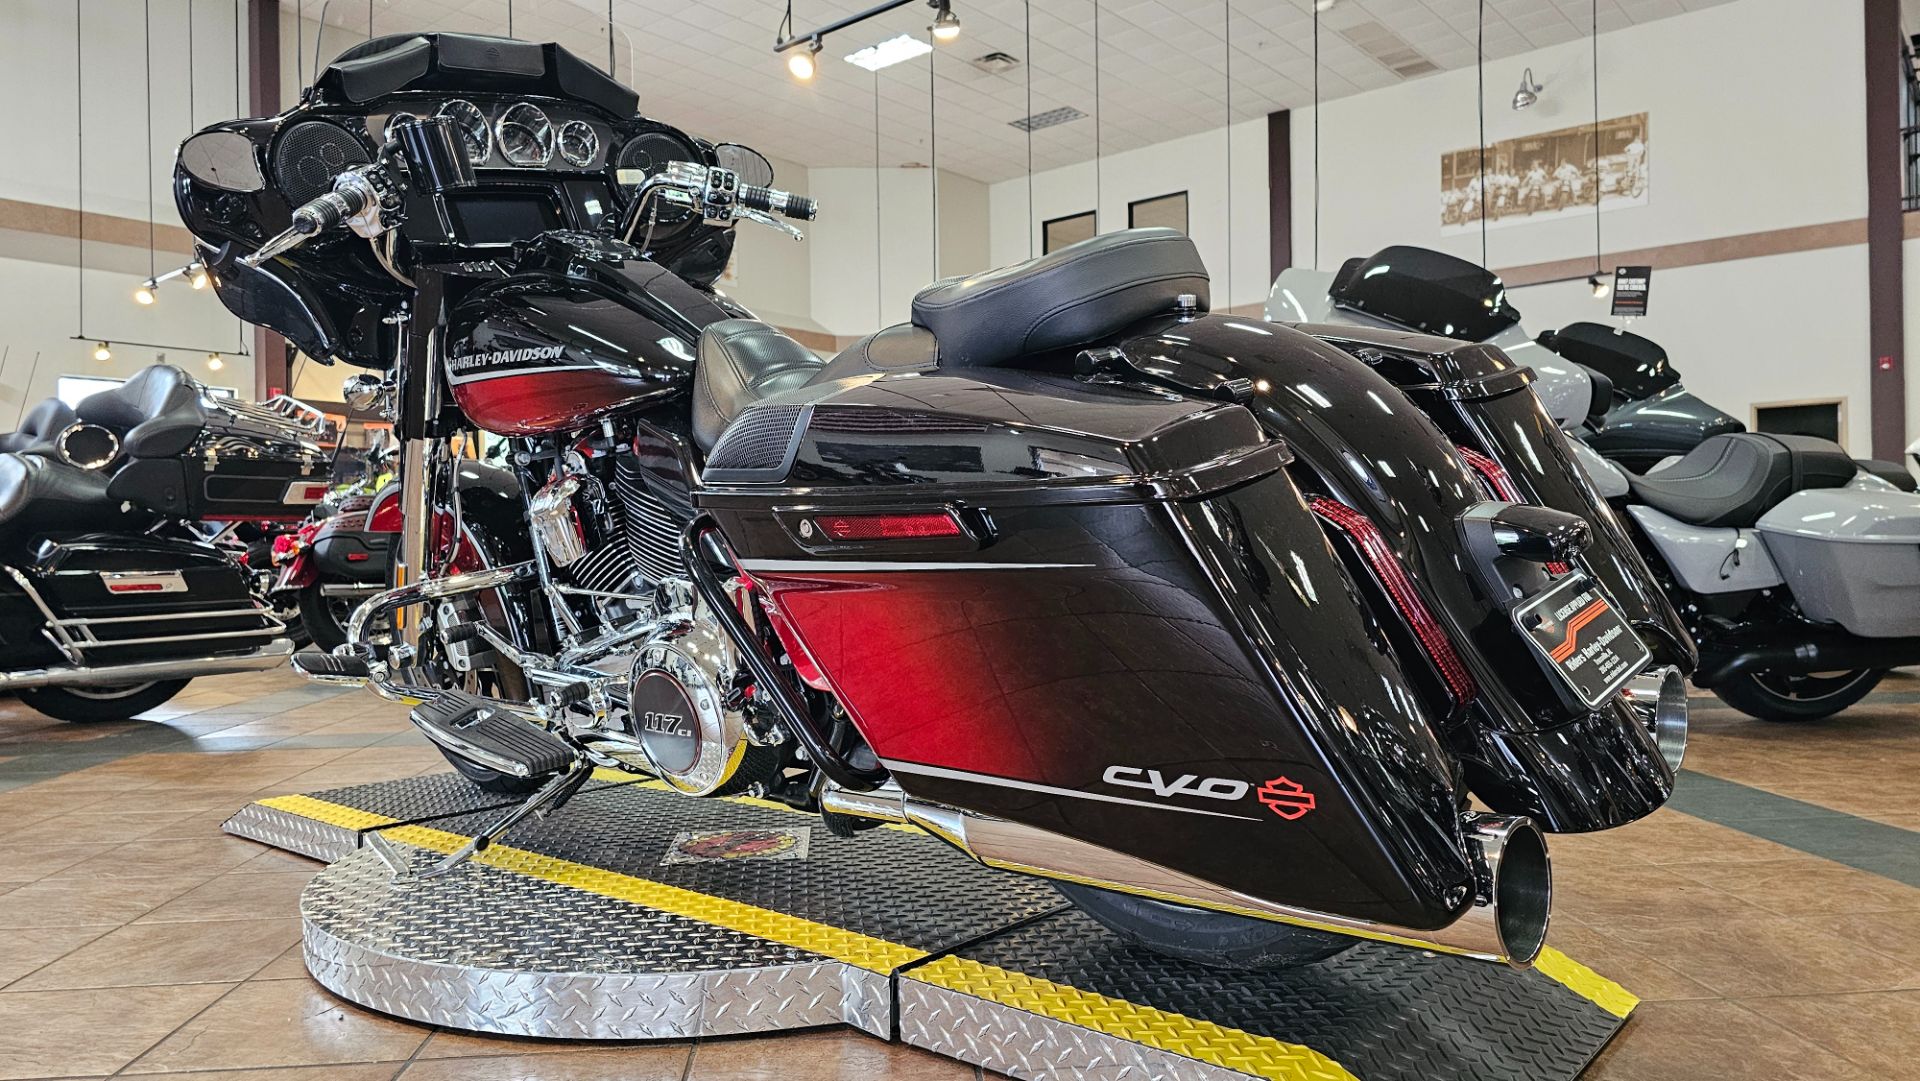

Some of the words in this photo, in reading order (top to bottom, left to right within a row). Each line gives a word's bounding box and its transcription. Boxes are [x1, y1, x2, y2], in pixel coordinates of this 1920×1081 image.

[1565, 652, 1587, 671] Riders
[645, 711, 683, 735] 117
[1102, 765, 1249, 800] CVO
